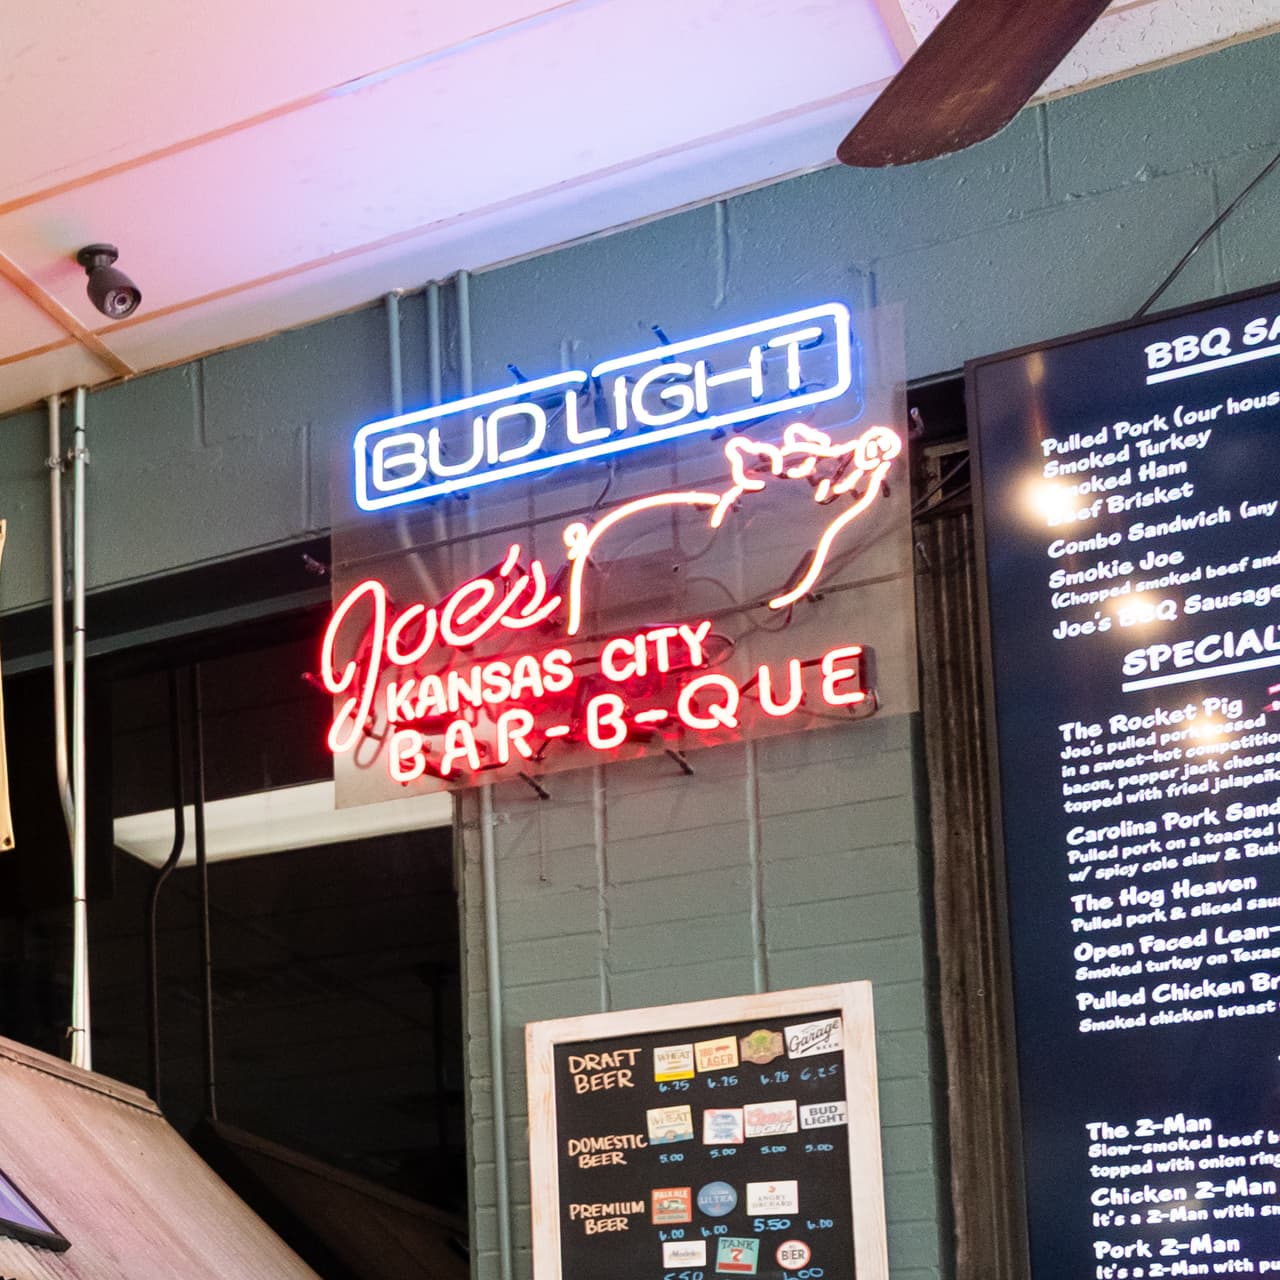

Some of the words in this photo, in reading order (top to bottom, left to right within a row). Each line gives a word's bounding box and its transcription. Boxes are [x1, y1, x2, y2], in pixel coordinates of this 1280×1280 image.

[1144, 327, 1231, 369] BBQ
[372, 402, 546, 492] BUD
[565, 327, 823, 445] LIGHT
[1041, 427, 1108, 456] Pulled
[1113, 415, 1169, 440] Pork
[1173, 405, 1223, 427] (our
[1043, 445, 1130, 478] Smoked
[1136, 429, 1212, 458] Turkey
[1138, 460, 1187, 482] Ham
[1106, 481, 1194, 514] Brisket
[1047, 532, 1122, 558] Combo
[1128, 506, 1231, 542] Sandwich
[1240, 500, 1278, 519] (any
[1049, 560, 1135, 589] Smokie
[1139, 551, 1185, 571] Joe
[1051, 581, 1131, 610] (Chopped
[1135, 566, 1202, 592] smoked
[1206, 557, 1249, 579] beef
[1052, 611, 1112, 640] Joe's
[1118, 599, 1178, 627] BBQ
[320, 544, 561, 753] Joe's
[1122, 624, 1280, 676] SPECIAL
[386, 648, 574, 725] KANSAS
[601, 620, 712, 681] CITY
[387, 645, 865, 783] BAR-B-QUE
[1058, 722, 1103, 742] The
[1109, 703, 1197, 734] Rocket
[1202, 697, 1243, 719] Pig
[1060, 740, 1104, 760] Joe's
[1107, 732, 1156, 755] pulled
[1093, 748, 1182, 773] sweet-hot
[1062, 778, 1115, 796] bacon,
[1118, 766, 1180, 789] pepper
[1181, 759, 1220, 781] jack
[1063, 792, 1123, 814] topped
[1126, 786, 1162, 804] with
[1166, 777, 1209, 799] fried
[1066, 820, 1157, 846] Carolina
[1162, 807, 1220, 831] Pork
[1067, 845, 1119, 865] Pulled
[1122, 839, 1163, 860] pork
[1204, 822, 1274, 845] toasted
[1095, 862, 1140, 880] spicy
[1142, 857, 1179, 873] cole
[1182, 852, 1221, 867] slaw
[1070, 893, 1114, 914] The
[1119, 885, 1165, 908] Hog
[1171, 876, 1257, 900] Heaven
[1071, 913, 1123, 933] Pulled
[1126, 908, 1168, 928] pork
[1191, 898, 1242, 918] sliced
[1074, 941, 1135, 963] Open
[1139, 928, 1208, 954] Faced
[1075, 960, 1142, 981] Smoked
[1145, 955, 1203, 973] turkey
[1076, 987, 1146, 1011] Pulled
[1152, 979, 1245, 1003] Chicken
[1078, 1013, 1146, 1033] Smoked
[1149, 1007, 1214, 1026] chicken
[1217, 1000, 1276, 1019] breast
[568, 1048, 642, 1074] DRAFT
[574, 1070, 635, 1094] BEER
[804, 1113, 846, 1126] LIGHT
[809, 1105, 838, 1116] BUD
[1086, 1121, 1130, 1141] The
[1134, 1113, 1212, 1136] Z-Man
[567, 1133, 649, 1155] DOMESTIC
[578, 1150, 627, 1169] BEER
[1088, 1134, 1213, 1158] Slow-smoked
[1217, 1130, 1264, 1149] beef
[1090, 1159, 1153, 1179] topped
[1156, 1156, 1195, 1172] with
[1198, 1154, 1246, 1170] onion
[1090, 1184, 1187, 1207] Chicken
[1194, 1175, 1277, 1200] Z-Man
[569, 1199, 645, 1220] PREMIUM
[753, 1219, 790, 1232] 5.50
[1092, 1210, 1126, 1227] It's
[1146, 1205, 1209, 1224] Z-Man
[1213, 1203, 1254, 1219] with
[584, 1217, 629, 1235] BEER
[721, 1239, 754, 1251] TANK
[1092, 1239, 1153, 1260] Pork
[1159, 1233, 1241, 1256] Z-Man
[1096, 1263, 1128, 1280] It's
[1148, 1260, 1209, 1277] Z-Man
[1213, 1257, 1254, 1273] with
